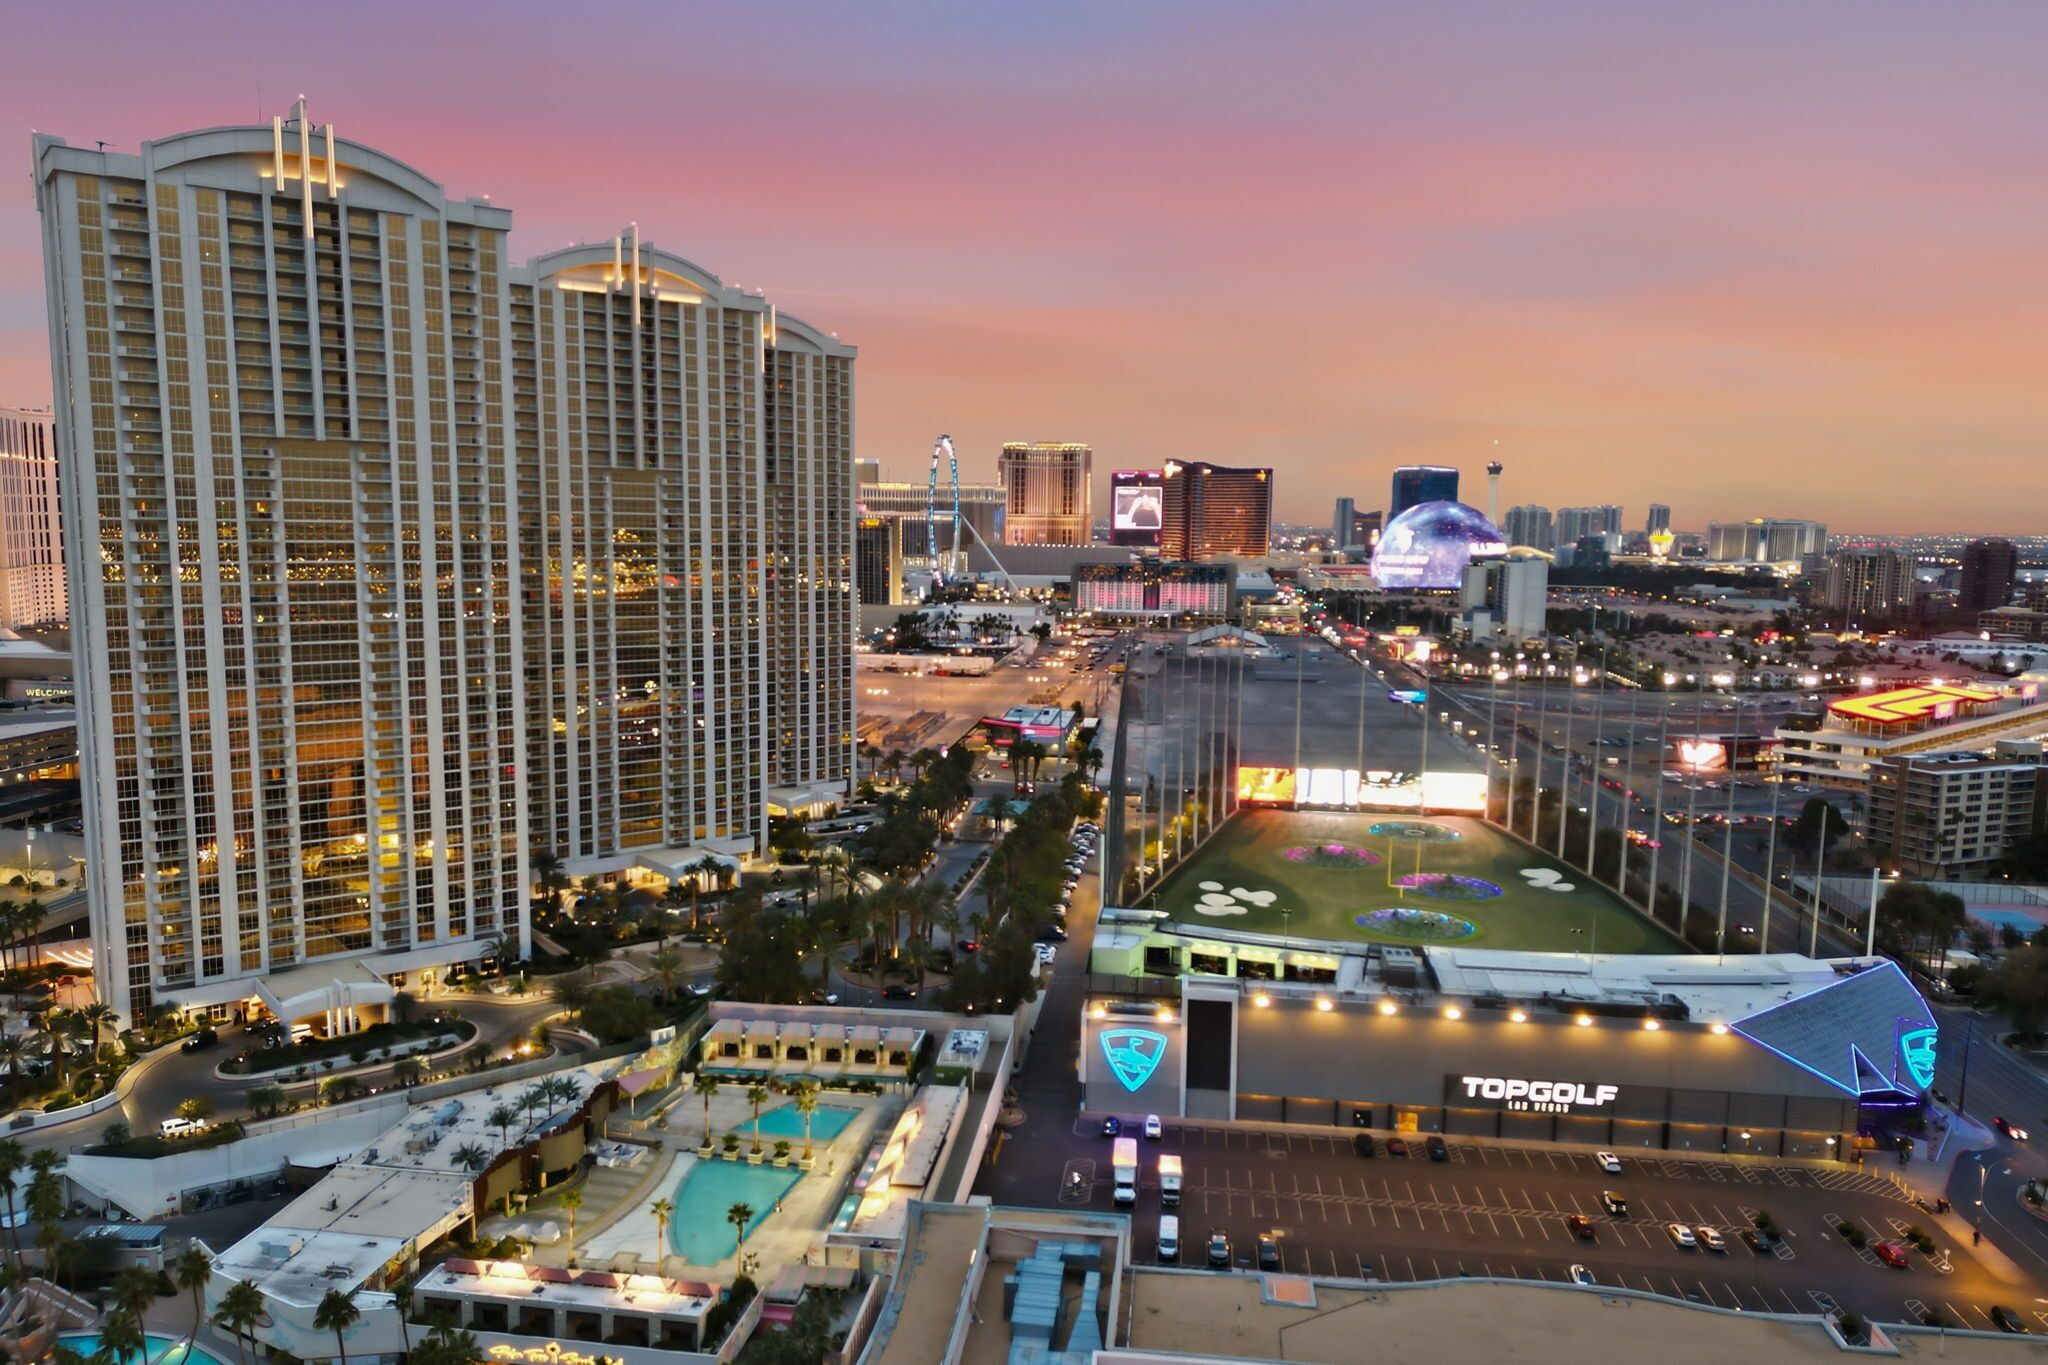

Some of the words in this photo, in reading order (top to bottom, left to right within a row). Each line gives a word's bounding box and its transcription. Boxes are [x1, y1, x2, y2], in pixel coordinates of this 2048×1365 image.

[1462, 1076, 1619, 1106] TOPGOLF
[1508, 1100, 1528, 1111] LAS
[1534, 1101, 1570, 1114] VEGAS
